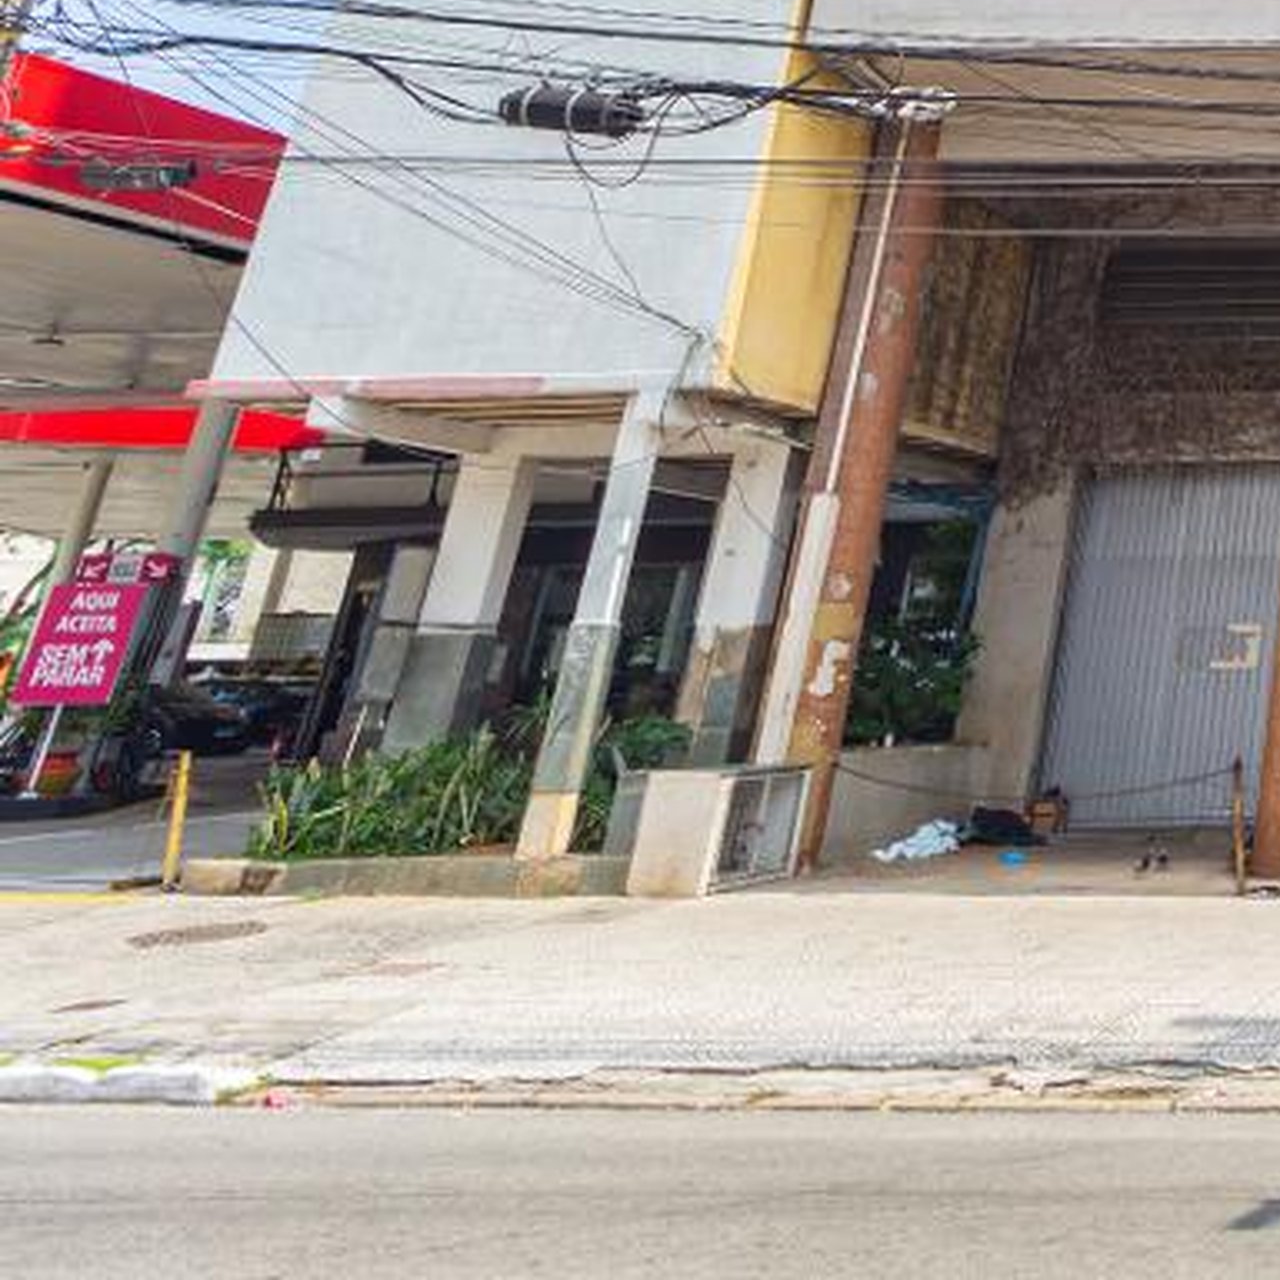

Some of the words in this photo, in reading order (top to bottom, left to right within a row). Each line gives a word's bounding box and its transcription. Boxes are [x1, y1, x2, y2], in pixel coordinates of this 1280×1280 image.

[70, 591, 120, 610] AQUI
[55, 614, 117, 633] ACEITA
[38, 643, 90, 666] SEM
[28, 665, 106, 687] PARAR
